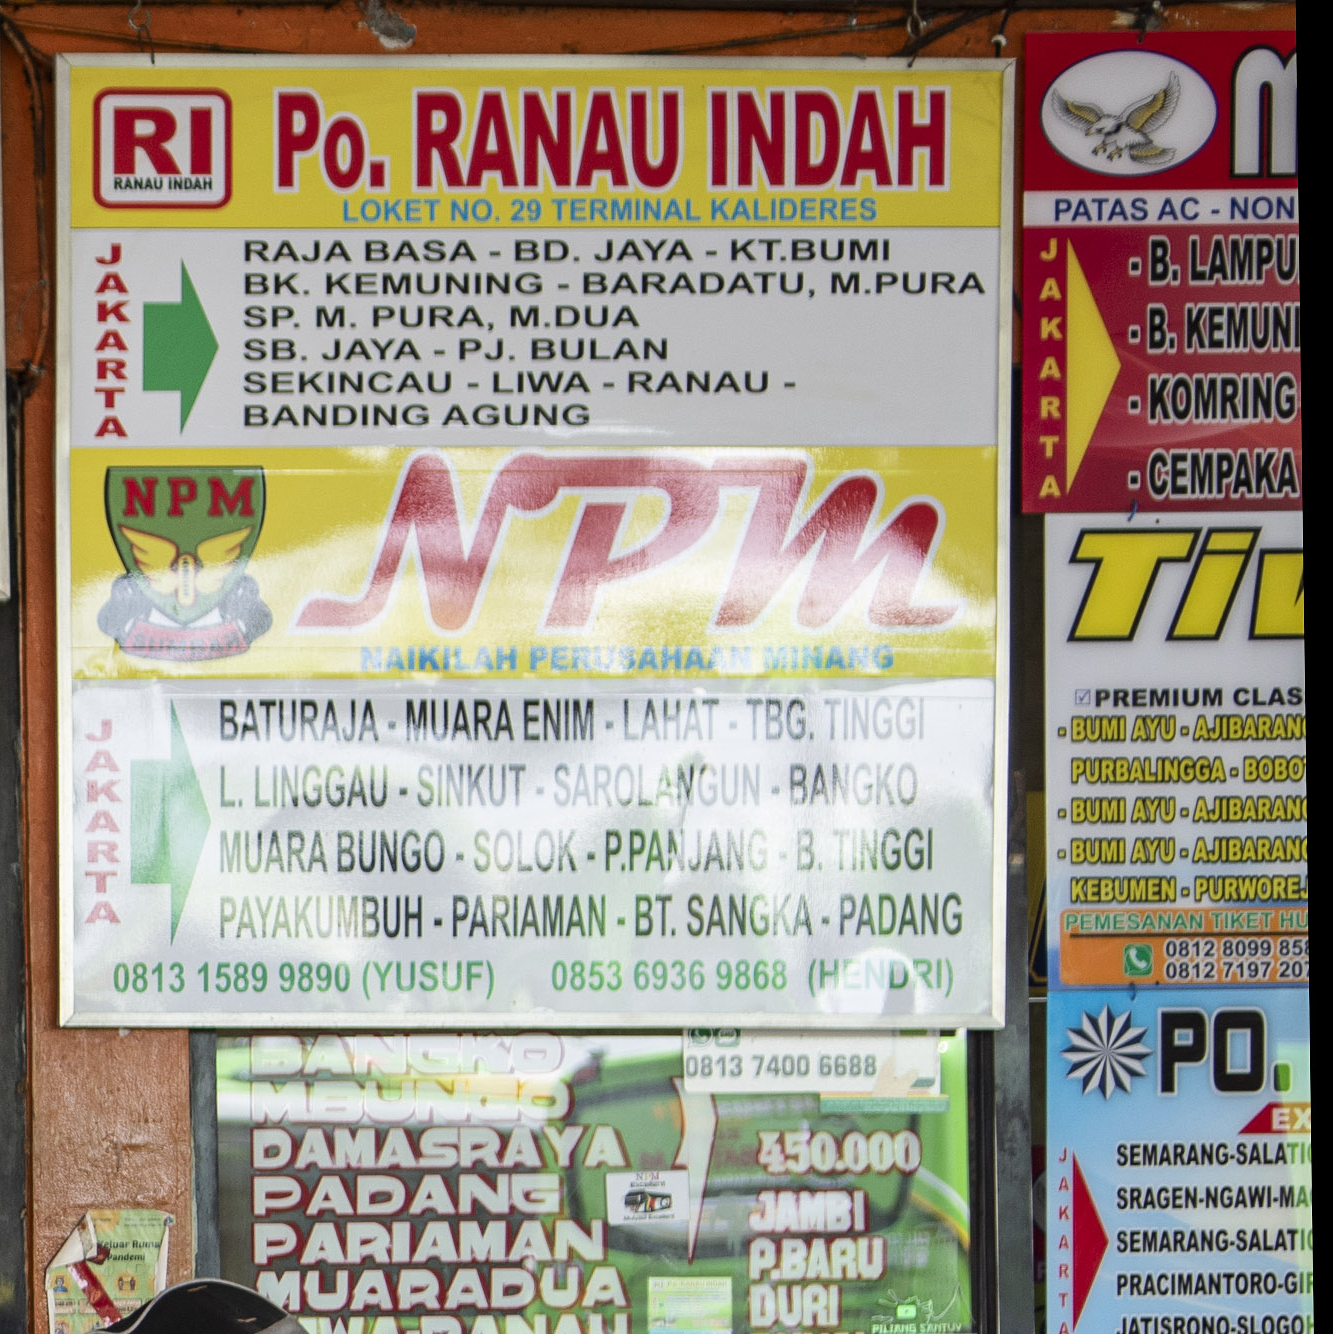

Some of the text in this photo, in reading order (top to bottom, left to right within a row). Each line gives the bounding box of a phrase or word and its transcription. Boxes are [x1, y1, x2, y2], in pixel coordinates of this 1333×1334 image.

[113, 106, 213, 174] RI
[275, 88, 947, 191] Po. RANAU INDAH
[113, 177, 213, 191] RANAU INDAH
[343, 198, 878, 223] LOKET NO. 29 TERMINAL KALIDERES
[1054, 199, 1148, 222] PATAS
[1158, 198, 1199, 219] AC
[244, 239, 892, 262] RAJA BASA BD. JAYA KT.BUMI
[1149, 375, 1296, 423] KOMRING
[121, 478, 255, 517] NPM
[293, 454, 955, 634] NPM
[1095, 688, 1223, 707] PREMIUM
[219, 699, 595, 743] BATURAJA MUARA ENIM
[1065, 912, 1274, 931] PEMESANAN TIKET
[1165, 940, 1274, 957] 0812 8099
[113, 959, 495, 997] 0813 1589 9890 (YUSUF)
[1165, 962, 1273, 979] 0812 7197
[686, 1054, 877, 1078] 0813 7400 6688
[1158, 1008, 1292, 1094] PO.
[252, 1126, 626, 1170] DAMASRAYA
[757, 1130, 921, 1174] 450.000
[749, 1190, 867, 1232] JAMBI
[252, 1220, 606, 1265] PARIAMAN
